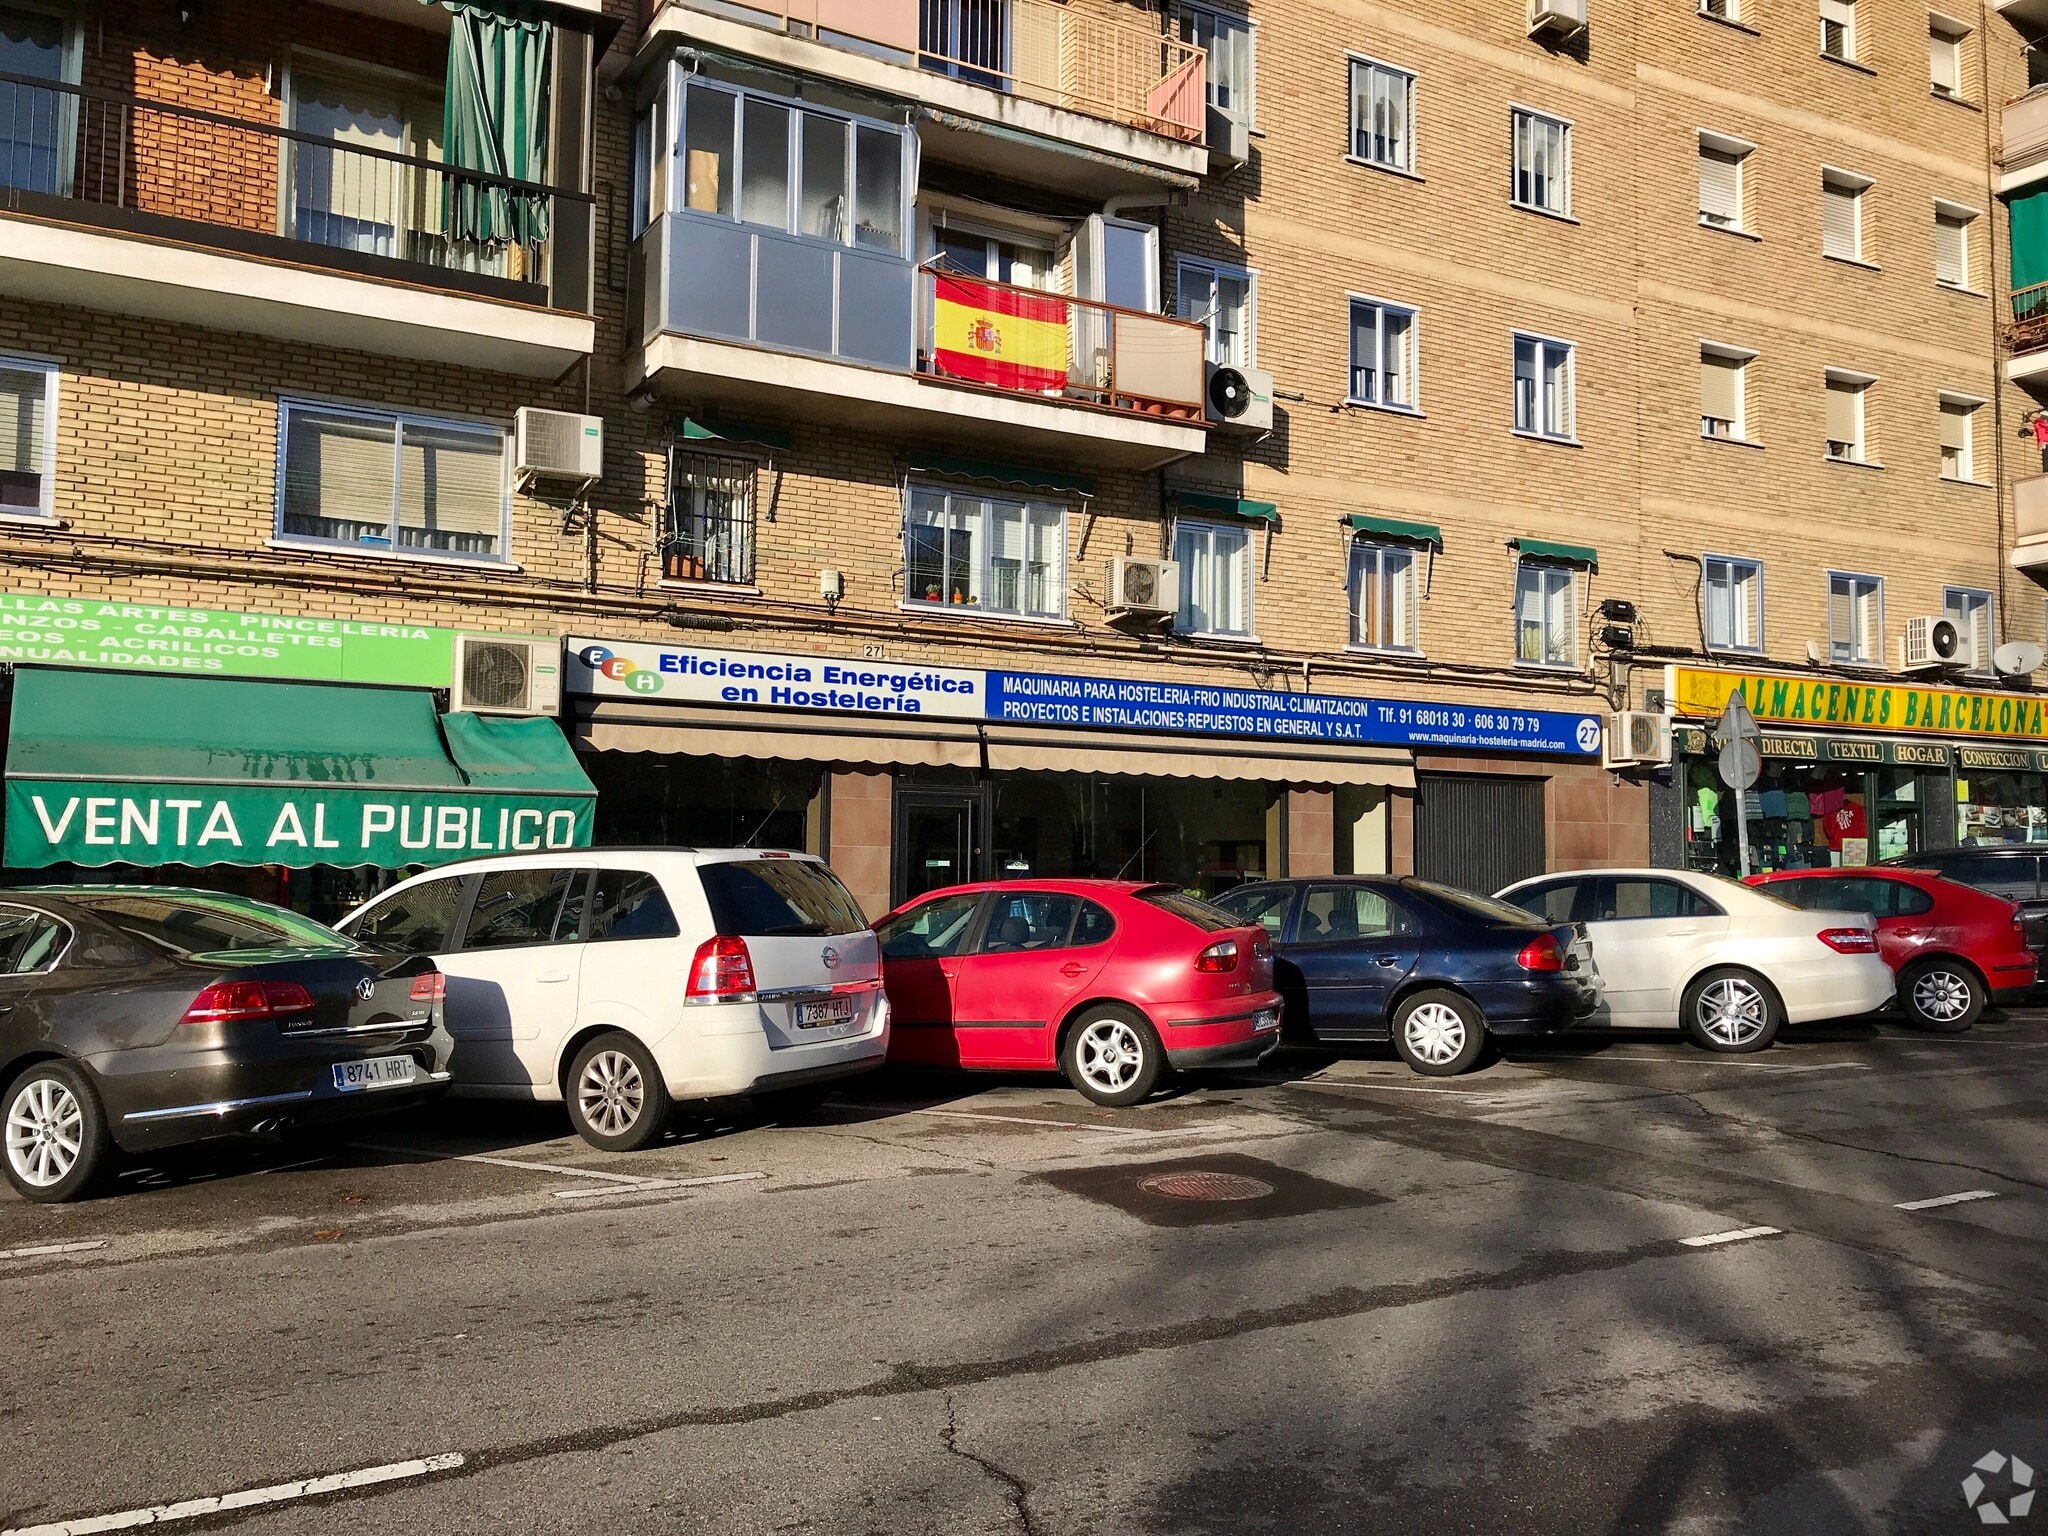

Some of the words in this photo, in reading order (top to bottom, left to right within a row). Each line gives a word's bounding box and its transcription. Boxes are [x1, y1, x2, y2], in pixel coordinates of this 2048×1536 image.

[3, 613, 101, 630] NZOS
[134, 623, 342, 648] CABALLETES
[96, 605, 209, 623] ARTES
[240, 616, 430, 640] PINCELERIA
[0, 630, 64, 644] EOS
[98, 636, 280, 658] ACRILICOS
[865, 645, 881, 658] 27
[0, 646, 223, 669] NUALIDADES
[659, 653, 812, 682] Eficiencia
[823, 665, 974, 694] Energética
[721, 686, 758, 702] en
[771, 686, 921, 713] Hostelería
[1003, 676, 1081, 698] MAQUINARIA
[1084, 682, 1116, 700] PARA
[1003, 701, 1079, 722] PROYECTOS
[1082, 706, 1090, 722] E
[1256, 717, 1271, 733] EN
[1274, 718, 1324, 736] GENERAL
[1325, 722, 1334, 737] Y
[1335, 722, 1362, 739] S.A.T.
[1378, 707, 1396, 723] Tlf.
[1399, 709, 1412, 724] 91
[1416, 709, 1449, 726] 68018
[1451, 712, 1465, 728] 30
[1474, 714, 1494, 729] 606
[1496, 715, 1509, 731] 30
[1511, 716, 1525, 732] 79
[1527, 717, 1540, 733] 79
[1904, 691, 2042, 734] BARCELONA
[1579, 726, 1598, 744] 27
[1761, 738, 1816, 757] DIRECTA
[1831, 742, 1880, 760] TEXTIL
[1897, 745, 1946, 764] HOGAR
[1962, 749, 2029, 768] CONFECCION
[32, 796, 243, 847] VENTA
[265, 802, 340, 848] AL
[361, 804, 576, 851] PUBLICO
[806, 1002, 829, 1021] 7387
[832, 1000, 849, 1018] HTJ
[347, 1062, 381, 1083] 8741
[386, 1059, 408, 1078] HRT
